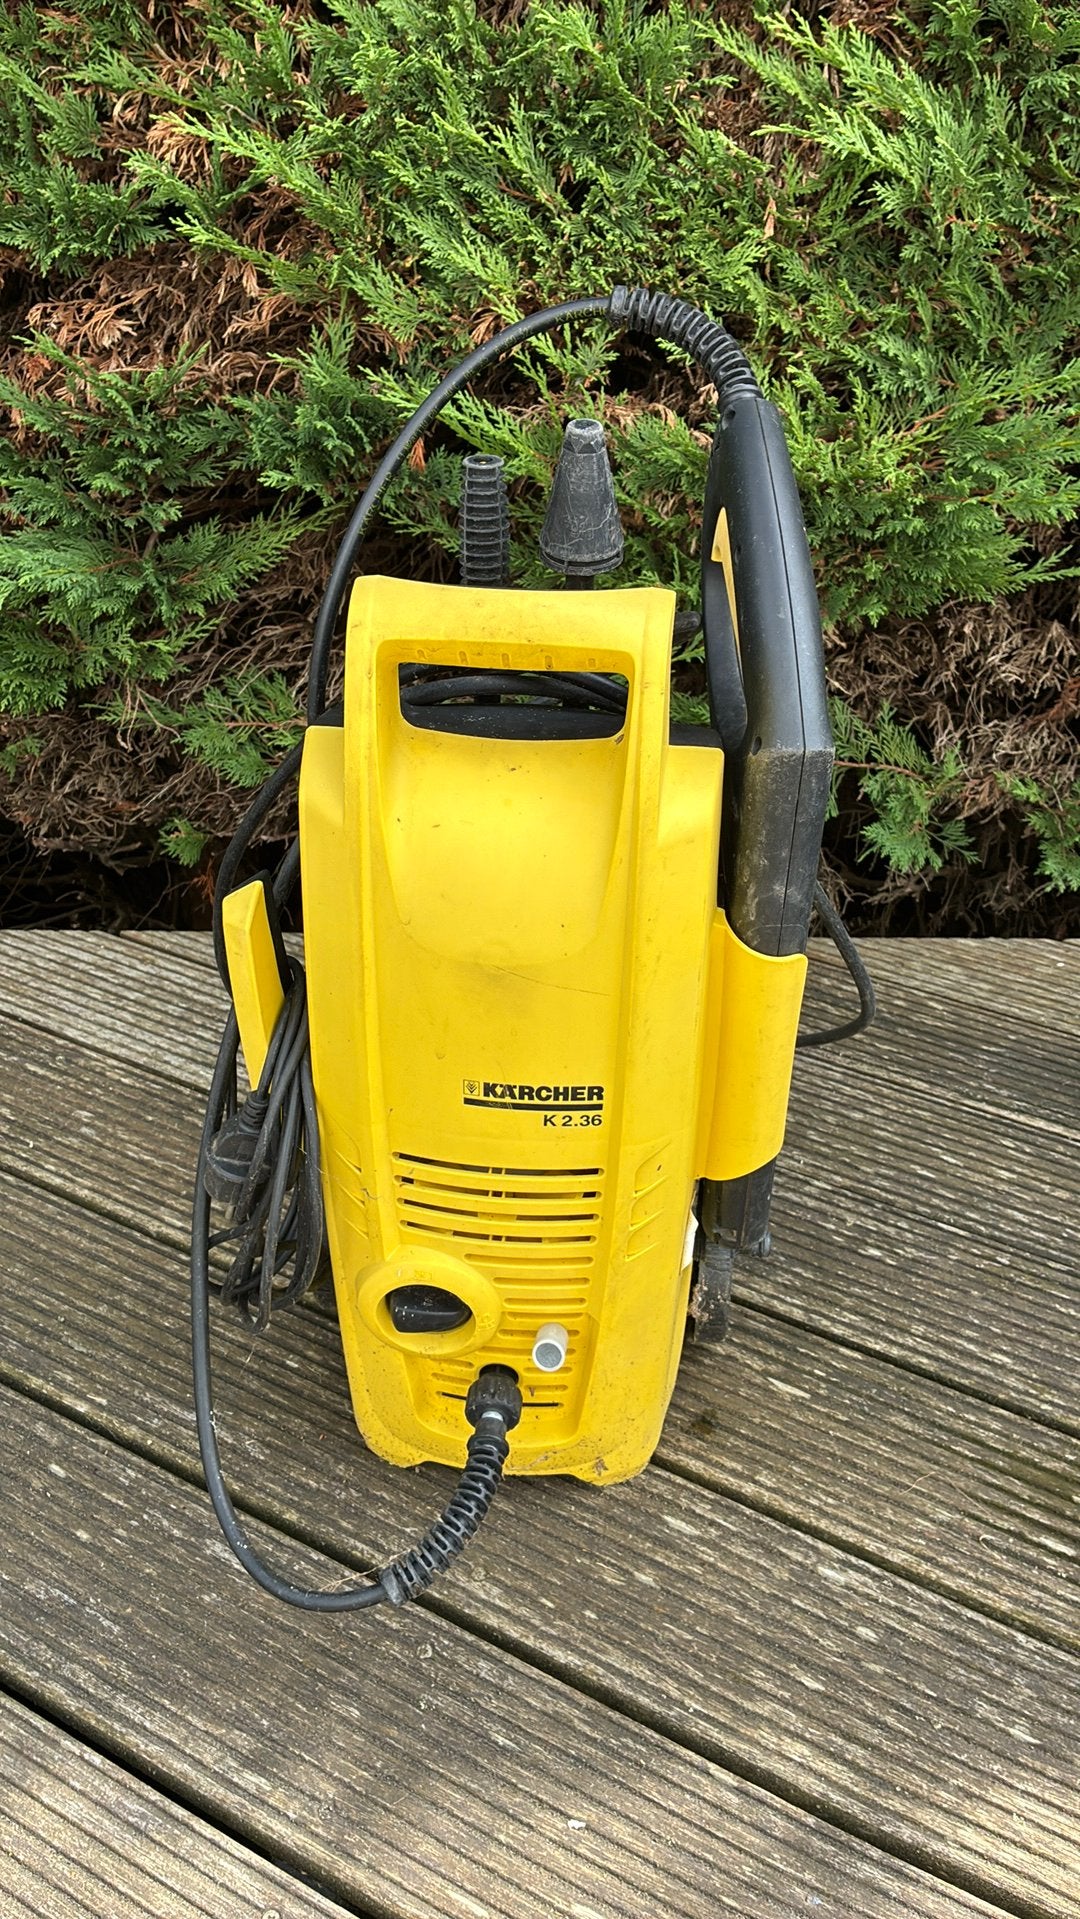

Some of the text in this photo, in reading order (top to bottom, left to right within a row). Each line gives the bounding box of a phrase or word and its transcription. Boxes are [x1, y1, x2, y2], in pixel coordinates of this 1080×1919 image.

[555, 306, 607, 322] KÄRCHE
[483, 1082, 604, 1101] KÄRCHER
[543, 1114, 602, 1126] K 2.36
